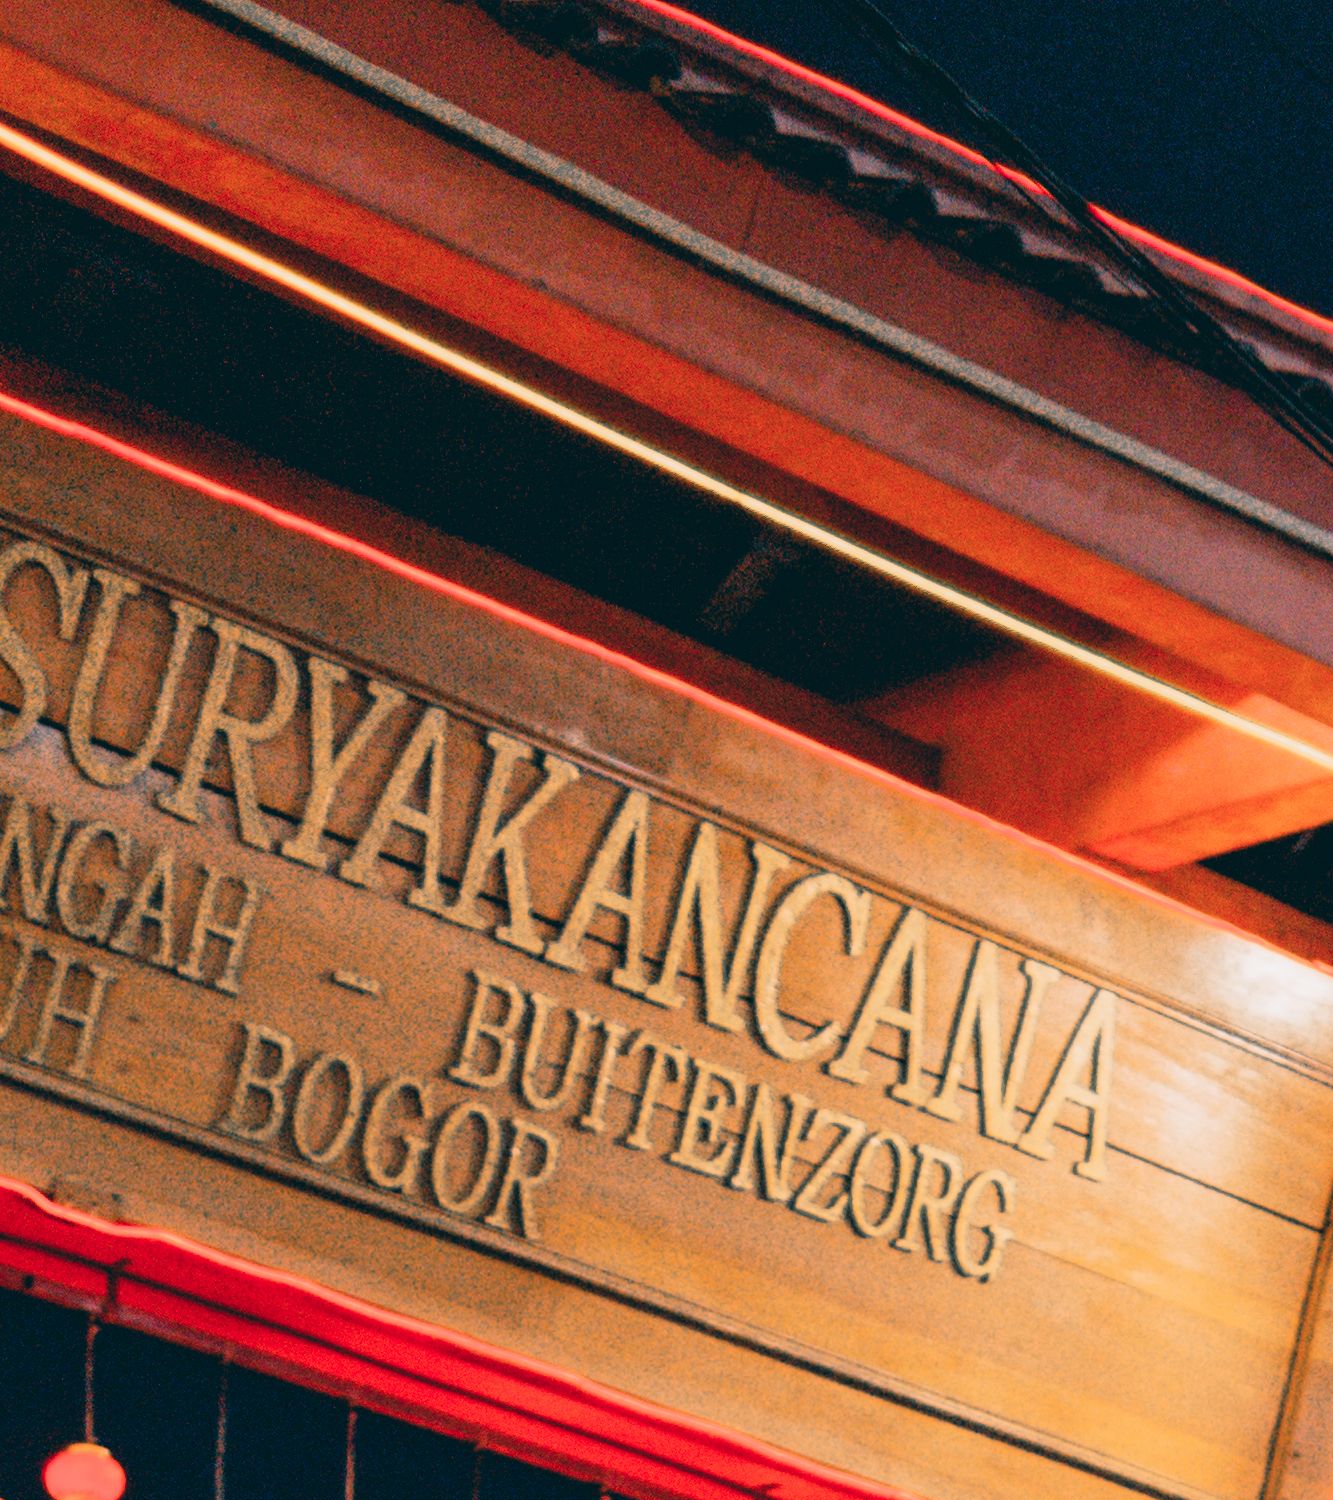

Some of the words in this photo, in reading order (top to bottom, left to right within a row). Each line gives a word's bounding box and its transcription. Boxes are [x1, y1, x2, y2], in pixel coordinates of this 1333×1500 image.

[0, 540, 1118, 1182] SURYAKANCANA
[219, 1022, 561, 1240] BOGOR
[448, 968, 1018, 1283] BUITENZORG
